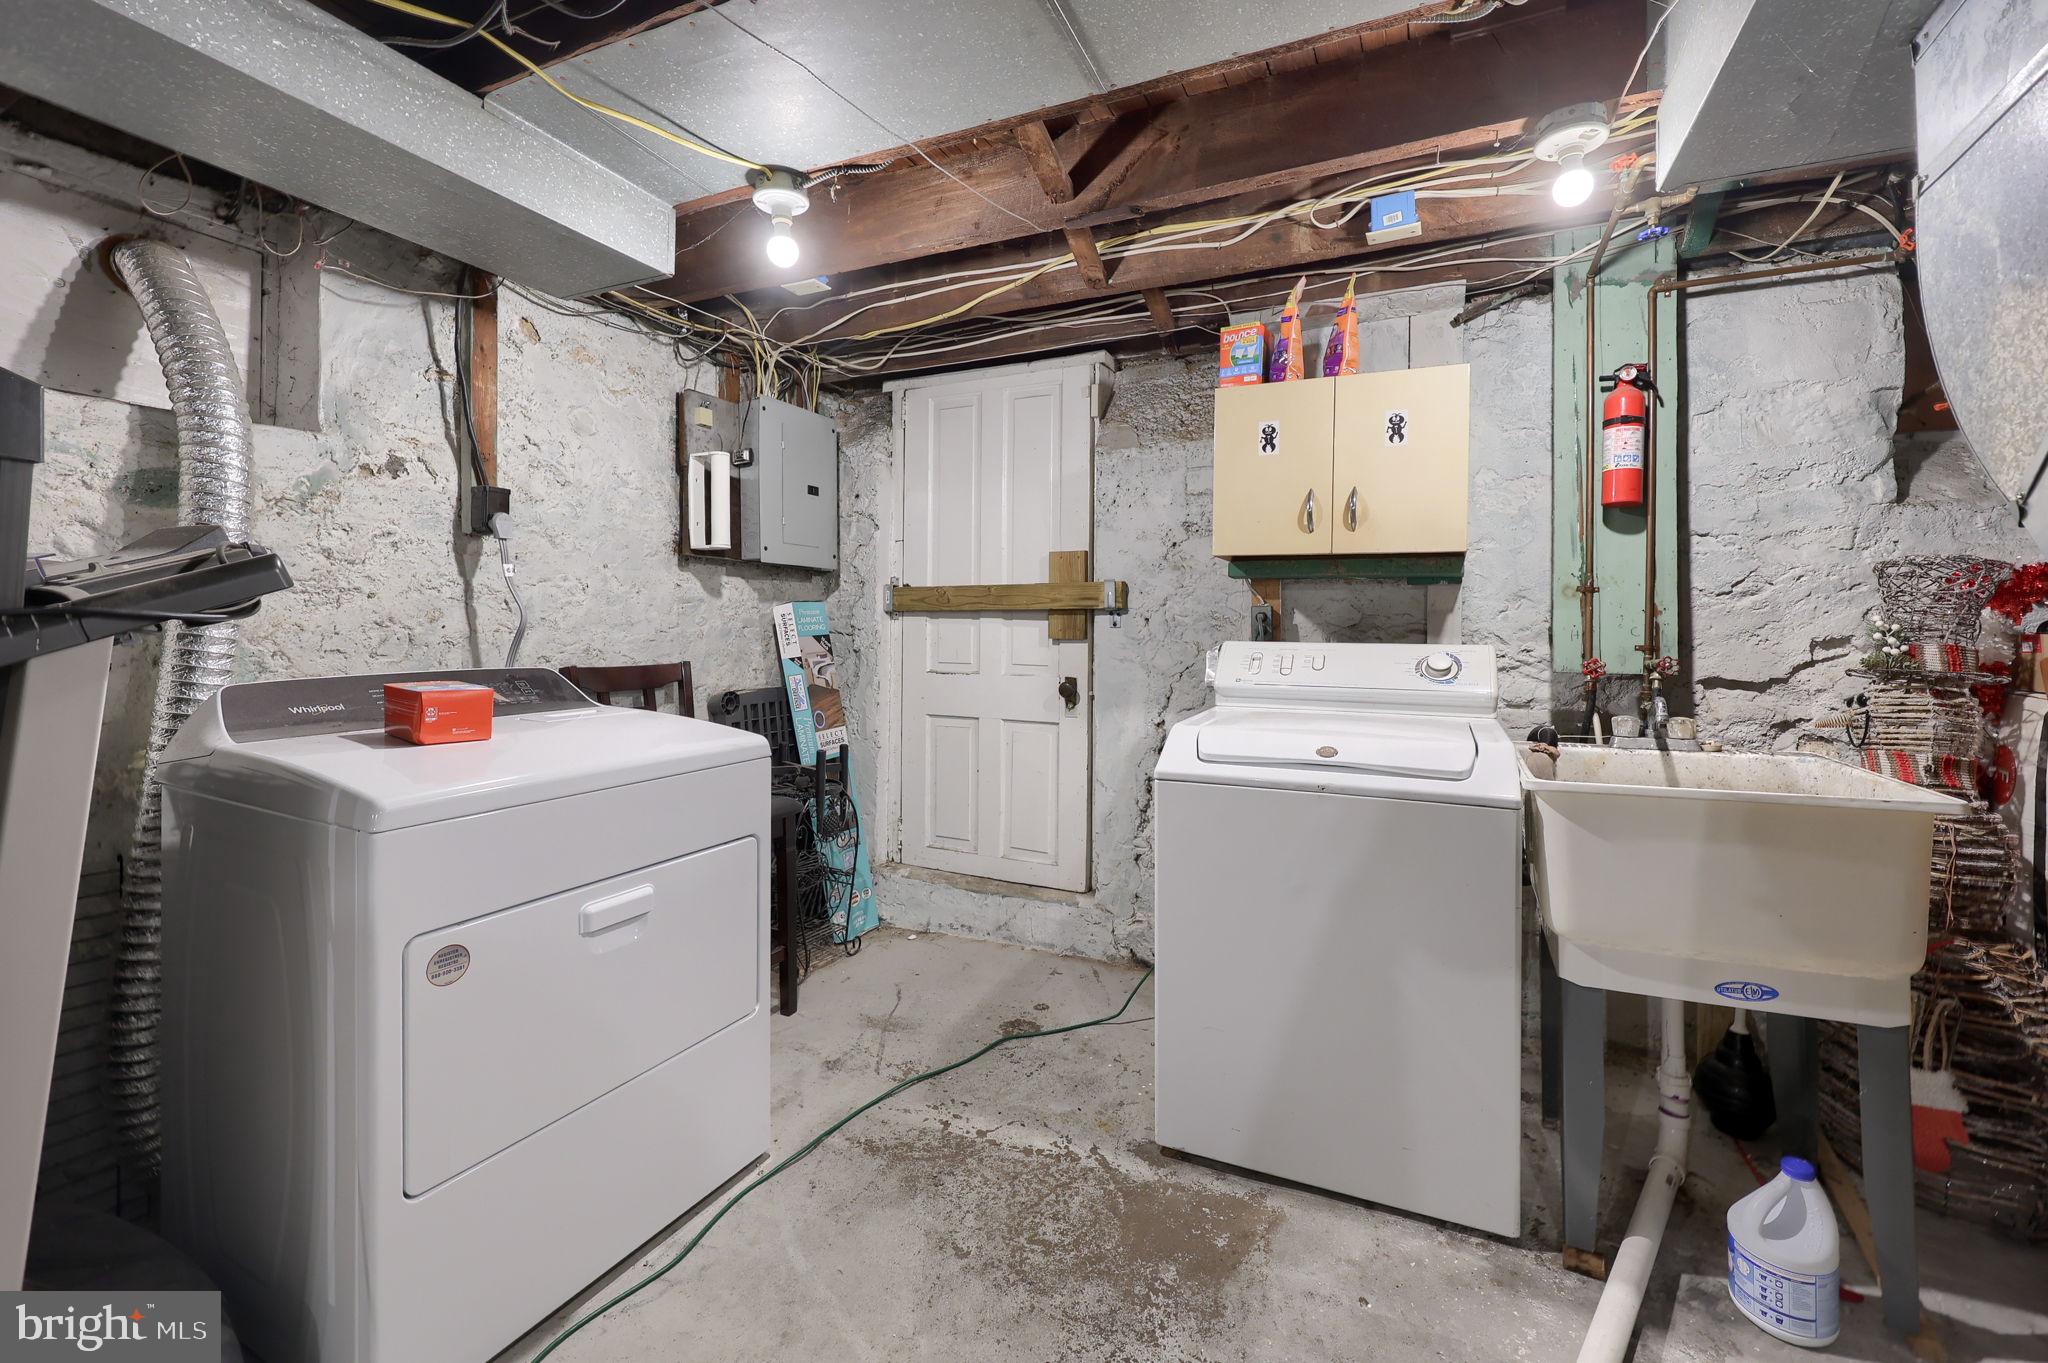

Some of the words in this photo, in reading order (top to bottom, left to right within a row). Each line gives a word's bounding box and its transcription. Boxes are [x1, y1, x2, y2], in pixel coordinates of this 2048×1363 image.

[1223, 328, 1257, 343] bounce
[780, 613, 791, 647] SURFACES
[288, 703, 346, 716] Whirlpool
[795, 718, 811, 765] LAMINATE
[818, 729, 845, 740] SELECT
[820, 737, 845, 748] SURFACES
